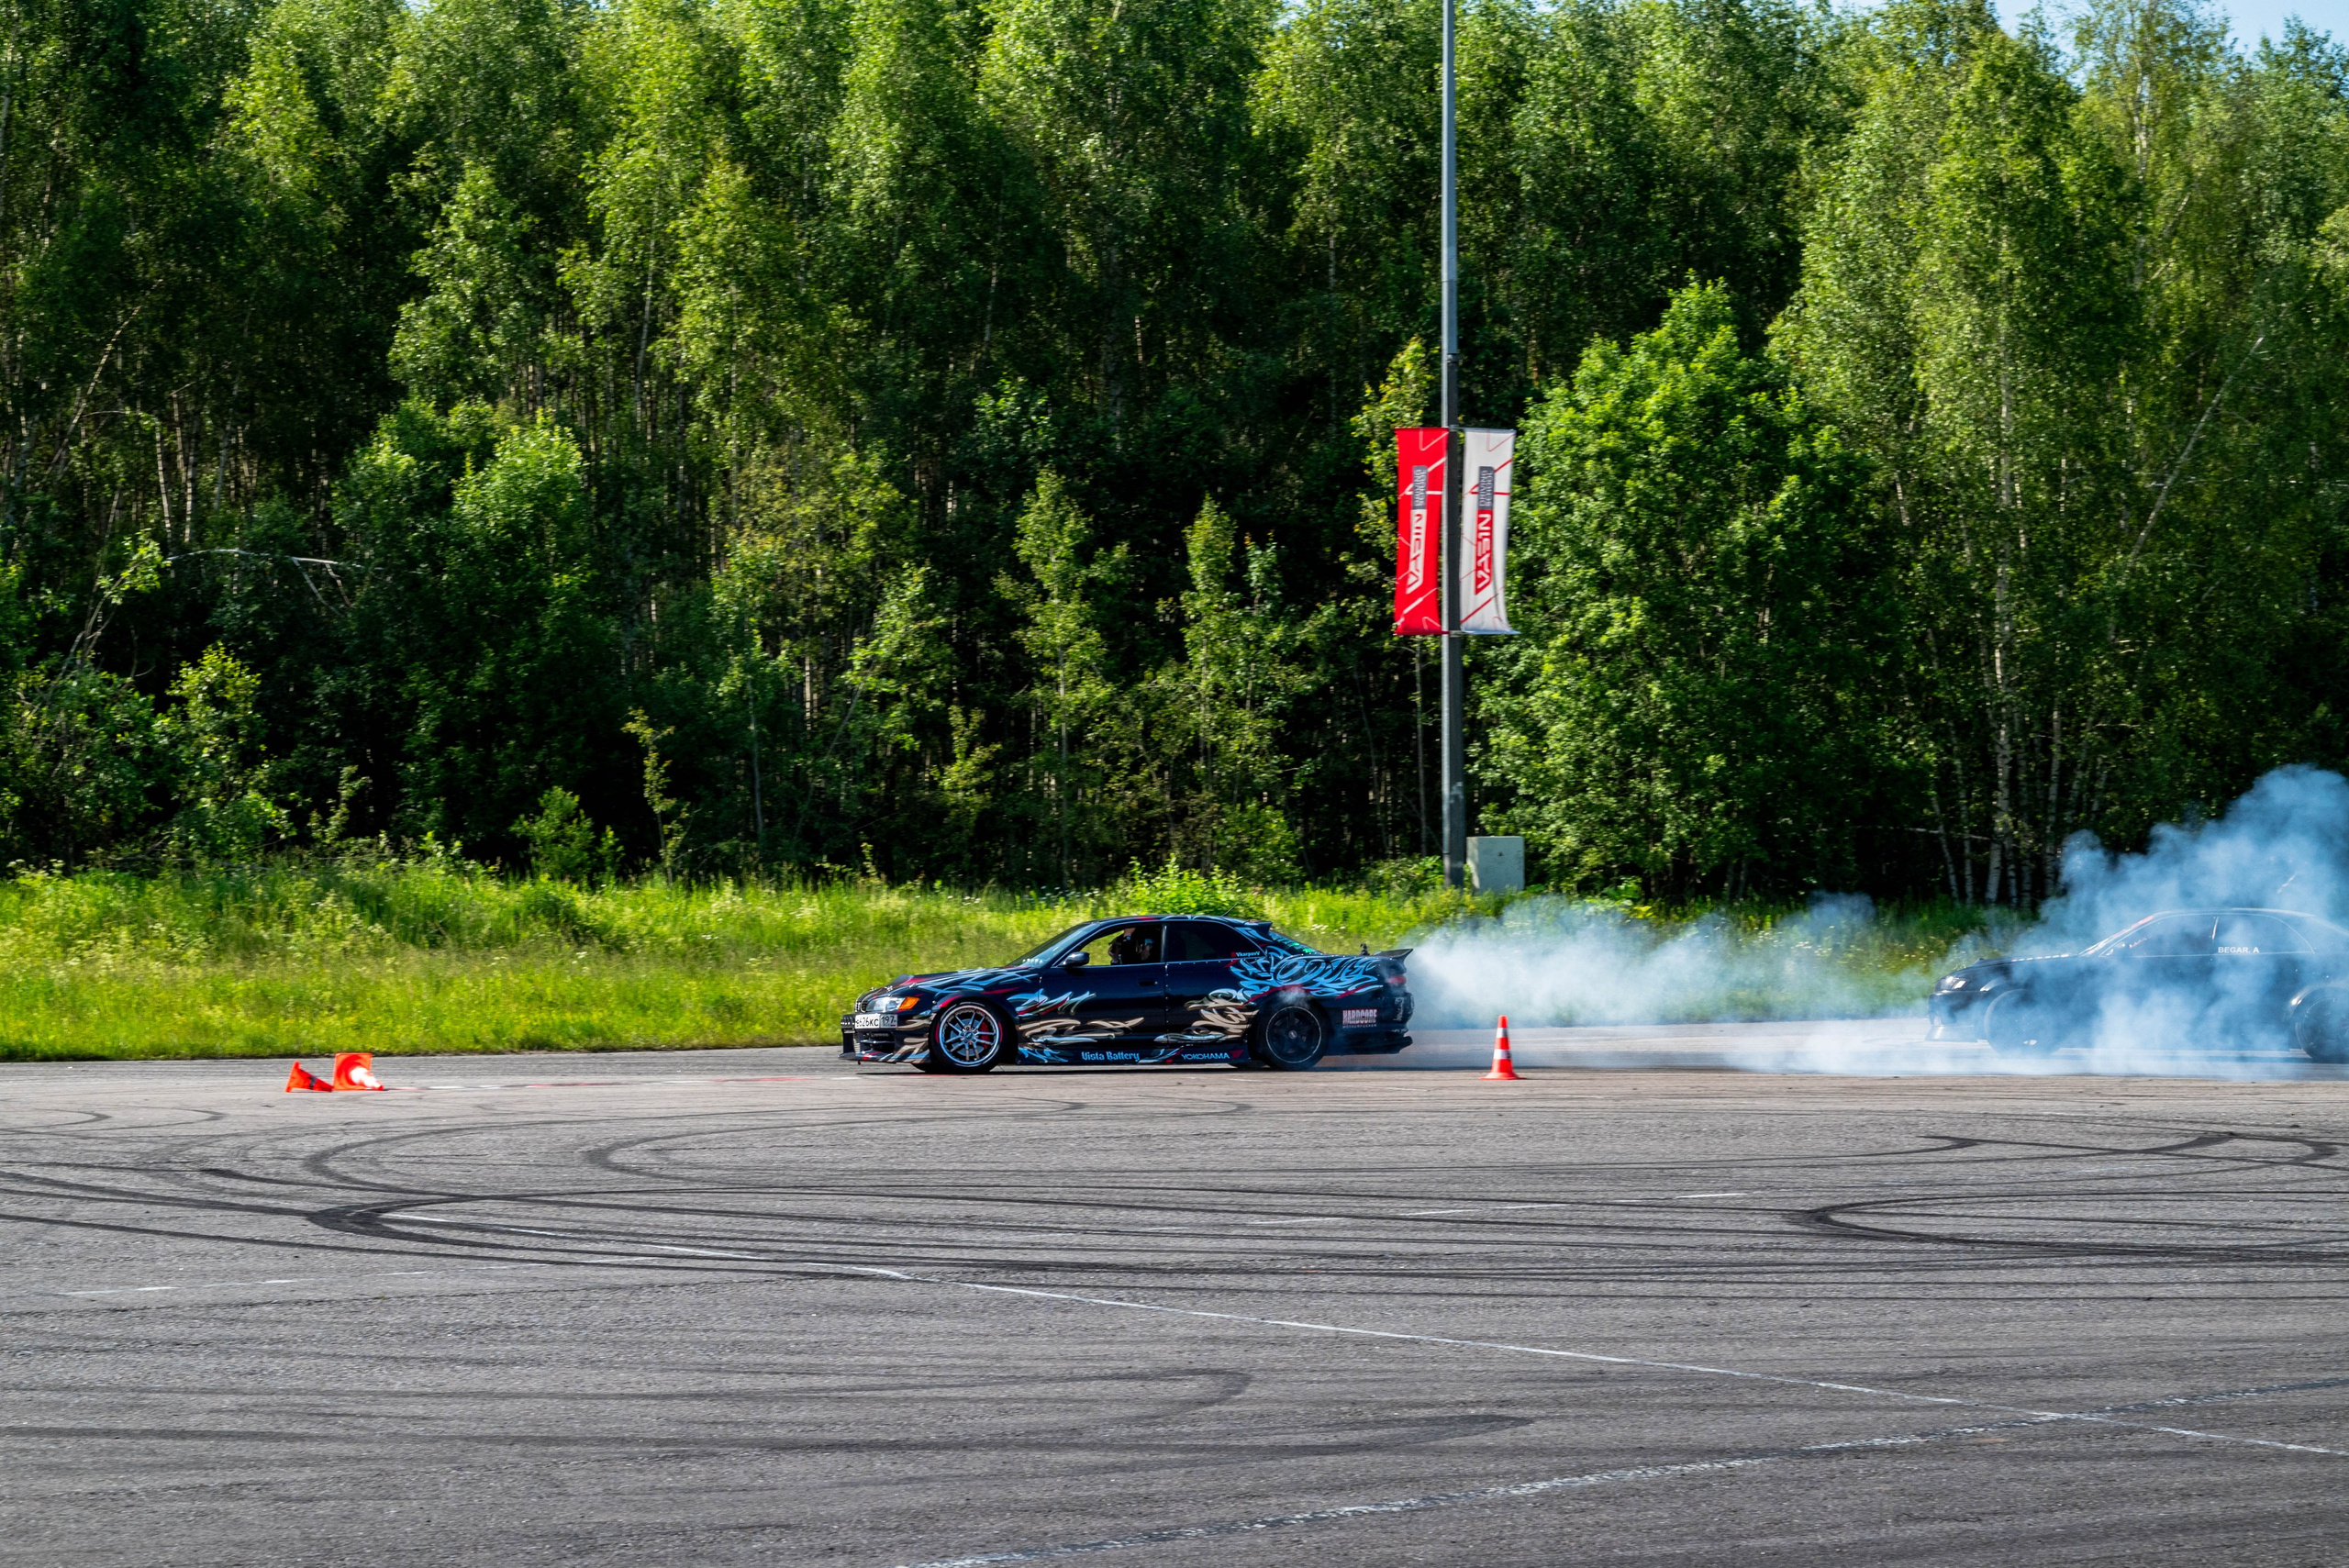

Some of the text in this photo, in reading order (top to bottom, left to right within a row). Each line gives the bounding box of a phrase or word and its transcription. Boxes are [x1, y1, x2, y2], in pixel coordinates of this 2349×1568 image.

[1407, 513, 1423, 589] VASIN
[1476, 513, 1492, 589] VASIN
[1342, 1009, 1377, 1025] HARDCORE
[1081, 1051, 1140, 1062] Vista Battery
